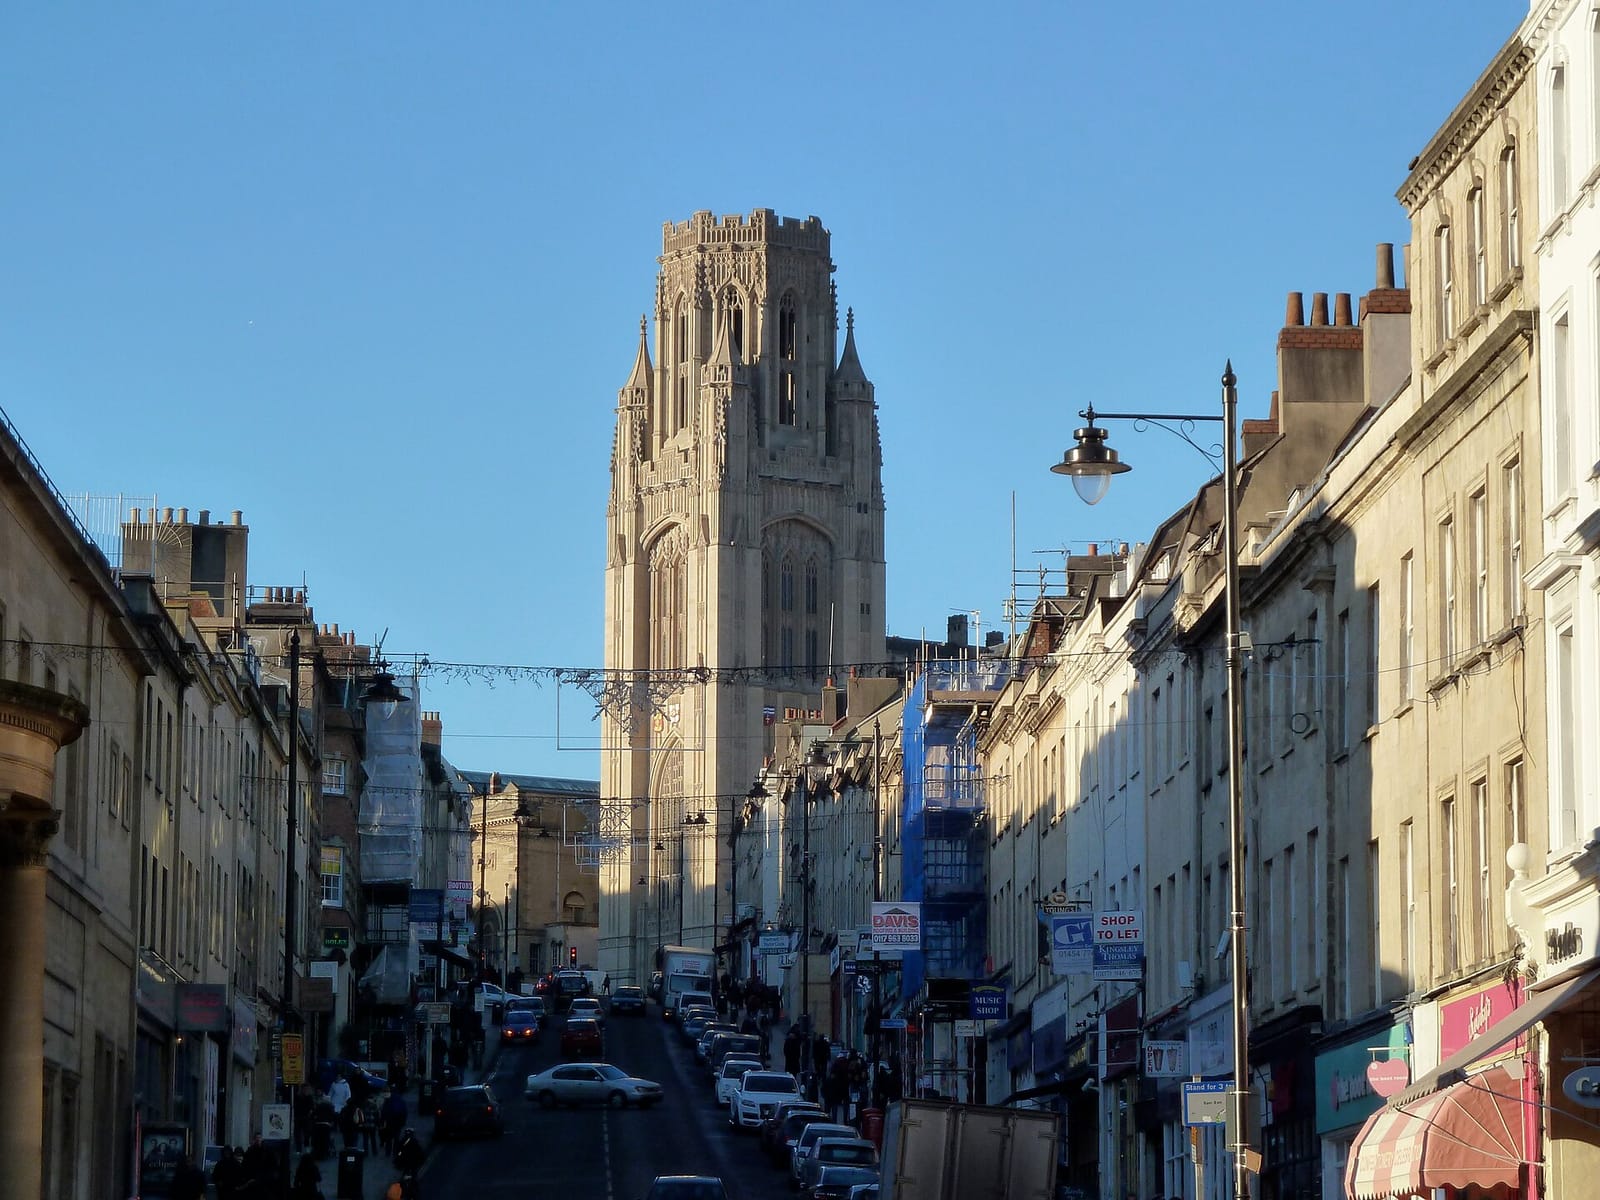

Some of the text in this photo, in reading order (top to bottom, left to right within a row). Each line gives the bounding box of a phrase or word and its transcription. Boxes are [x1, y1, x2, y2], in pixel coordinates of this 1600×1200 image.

[873, 915, 919, 928] DAVIS
[1101, 916, 1135, 926] SHOP
[1097, 930, 1140, 940] TO LET
[1099, 944, 1138, 953] KINGSLEY
[1103, 953, 1137, 961] THOMAS
[975, 996, 1002, 1004] MUSIC
[976, 1007, 1000, 1015] SHOP
